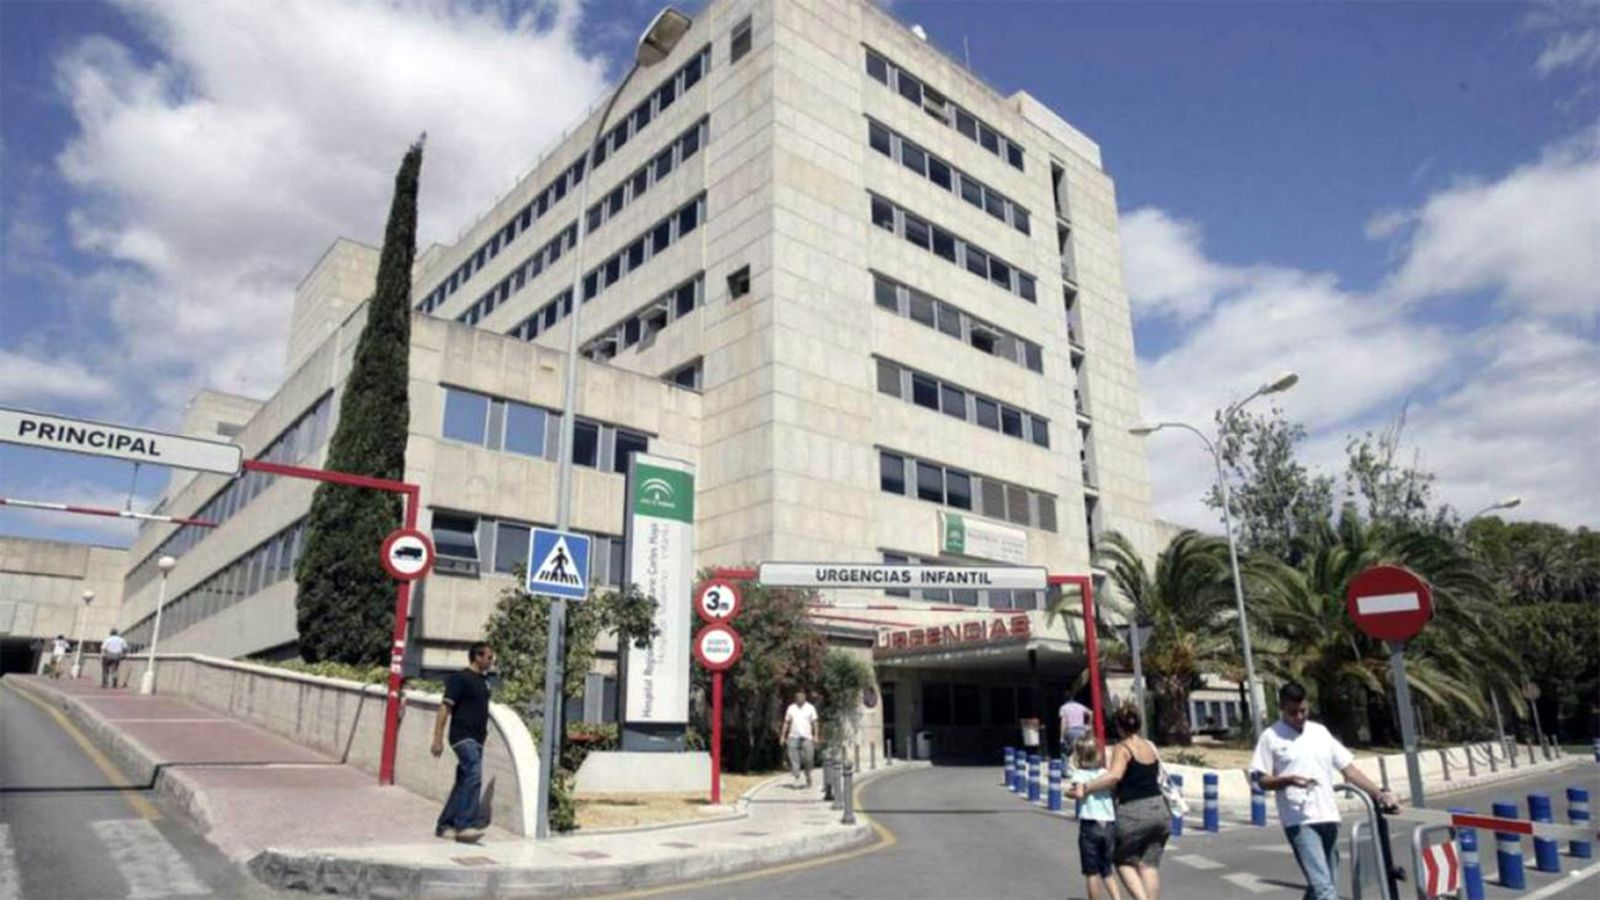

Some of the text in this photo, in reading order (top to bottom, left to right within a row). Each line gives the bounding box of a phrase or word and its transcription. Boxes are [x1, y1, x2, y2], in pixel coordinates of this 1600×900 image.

[18, 419, 162, 457] PRINCIPAL
[816, 568, 992, 585] URGENCIAS INFANTIL
[877, 615, 1031, 649] URGENCIAS
